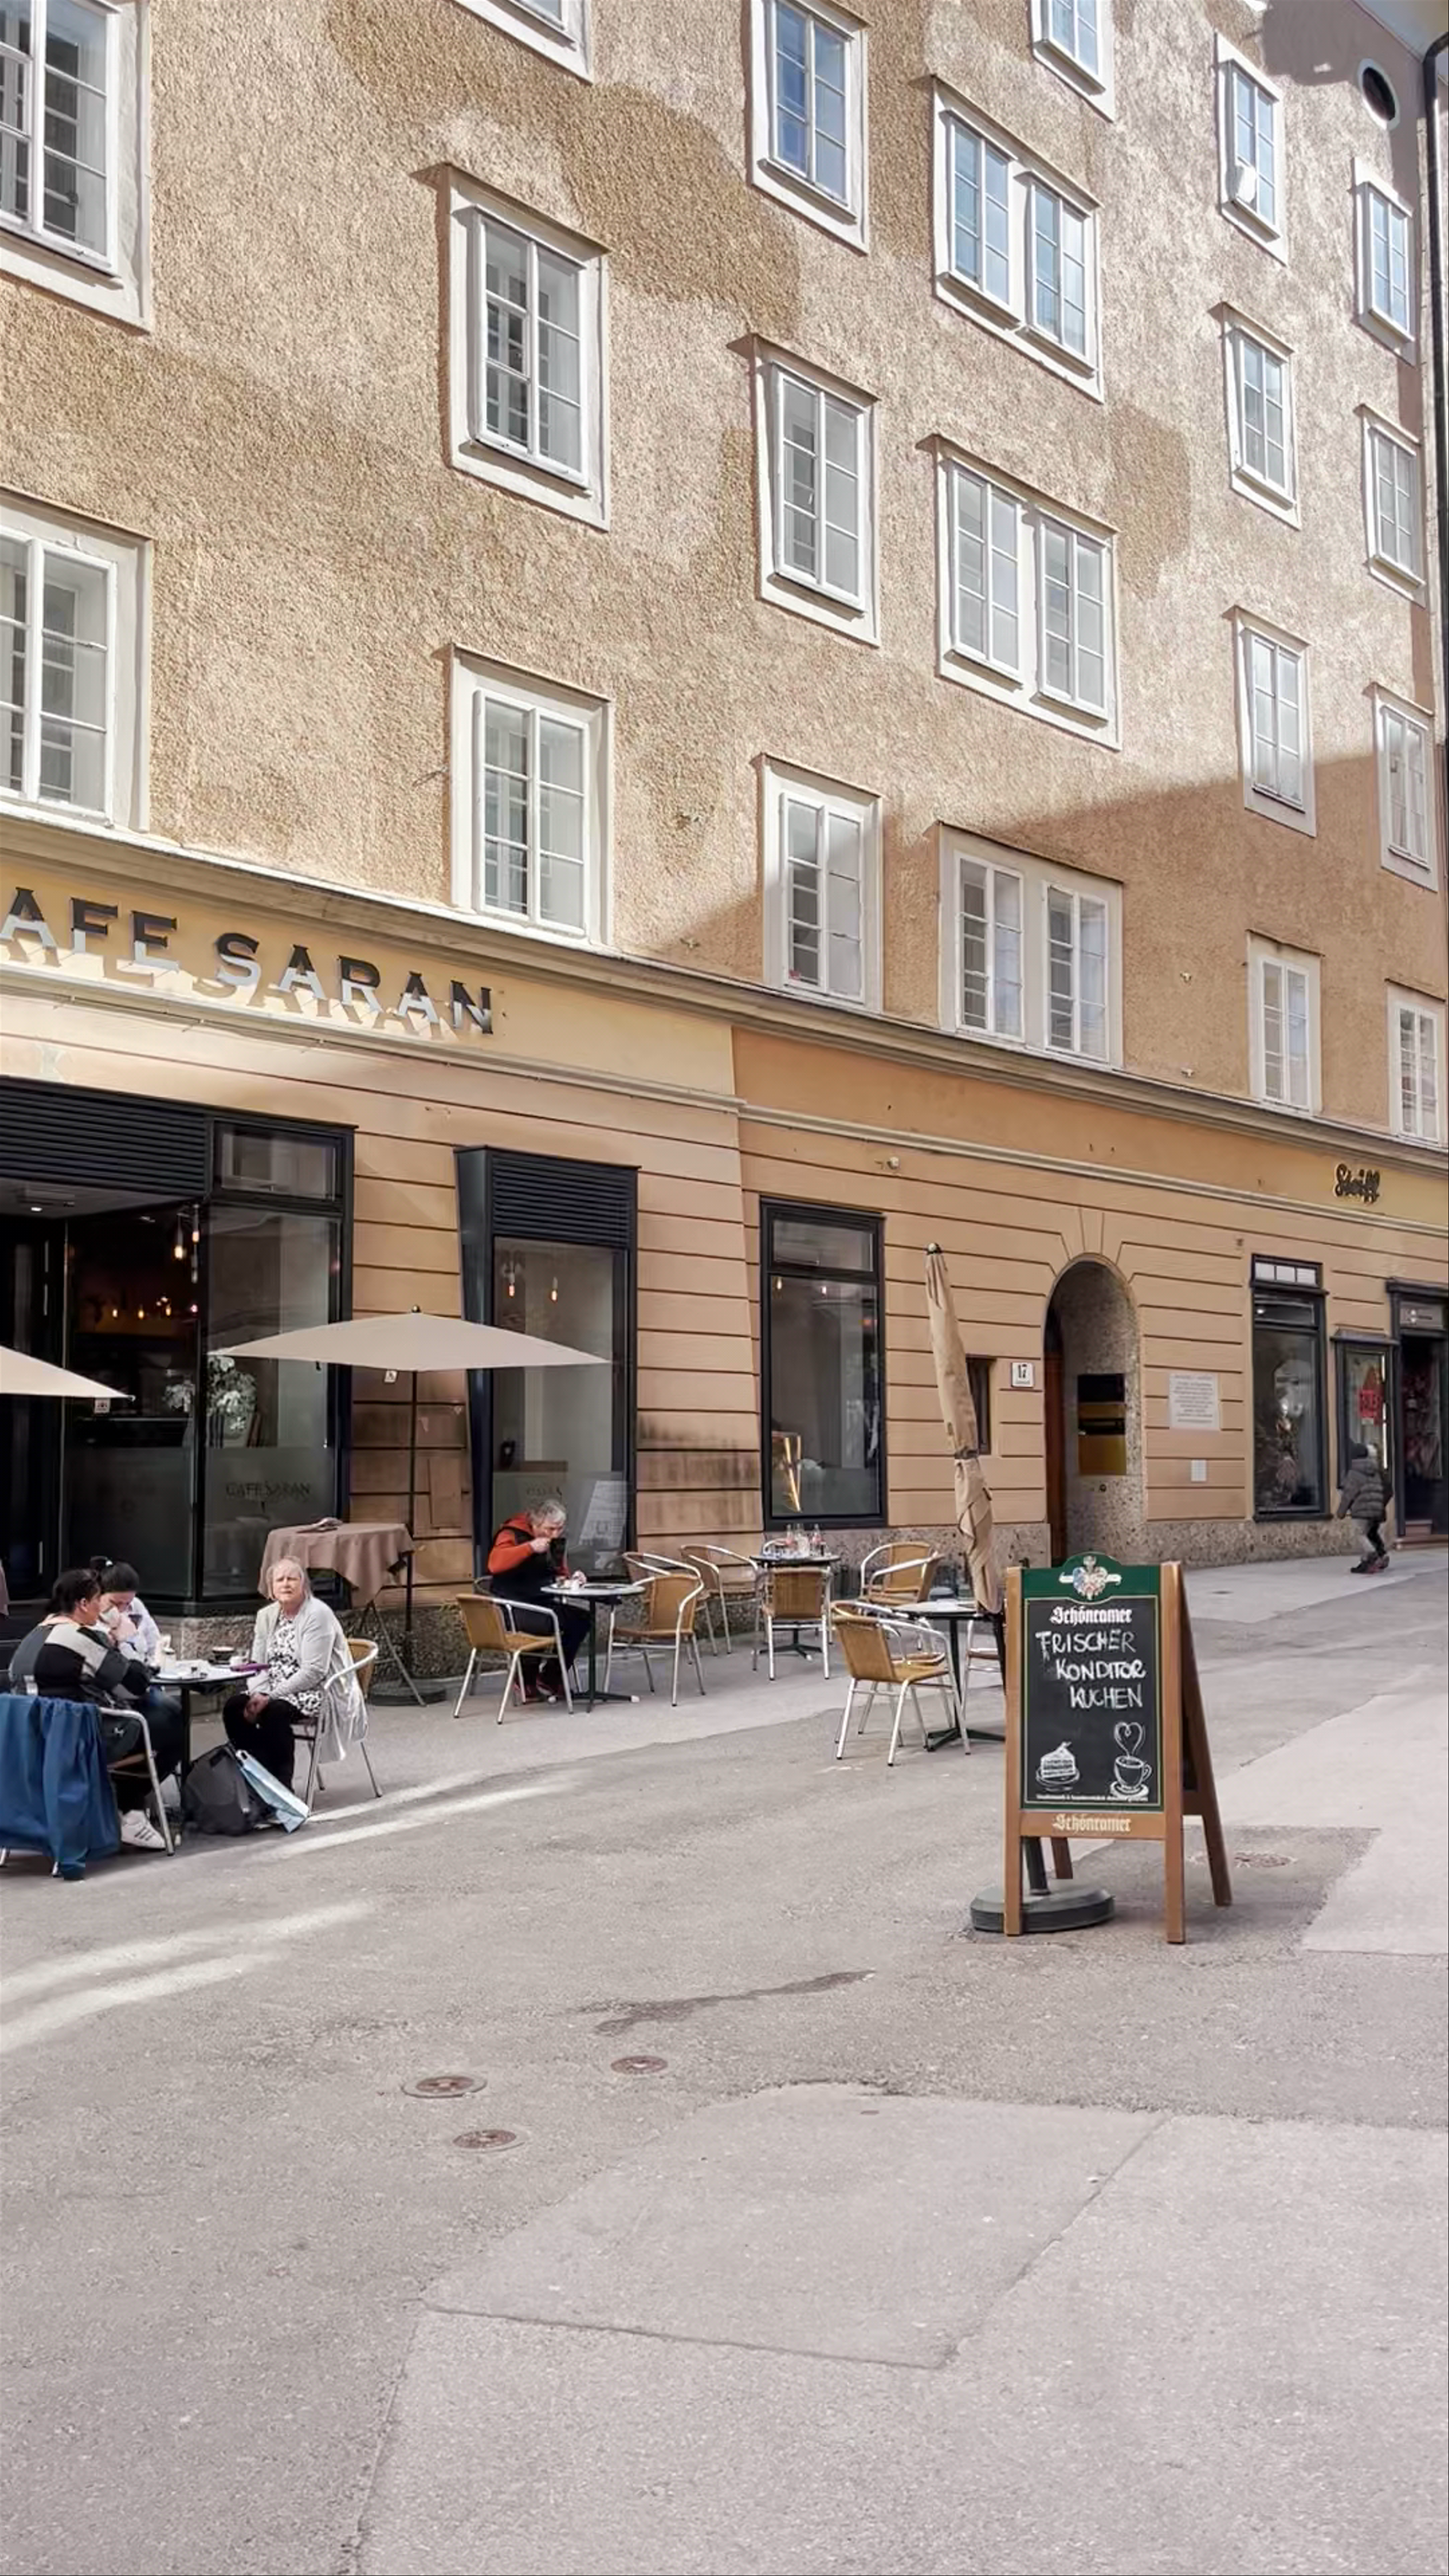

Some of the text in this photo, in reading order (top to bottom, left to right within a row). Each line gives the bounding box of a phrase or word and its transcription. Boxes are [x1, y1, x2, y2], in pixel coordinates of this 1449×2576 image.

[214, 932, 494, 1034] SARAN
[1334, 1163, 1380, 1204] Steiff
[1018, 1363, 1028, 1379] 17
[1049, 1606, 1132, 1626] Schönramer
[1035, 1629, 1137, 1661] FRISCHER
[1056, 1658, 1146, 1681] KONDITOR
[1070, 1683, 1143, 1709] KUCHEN
